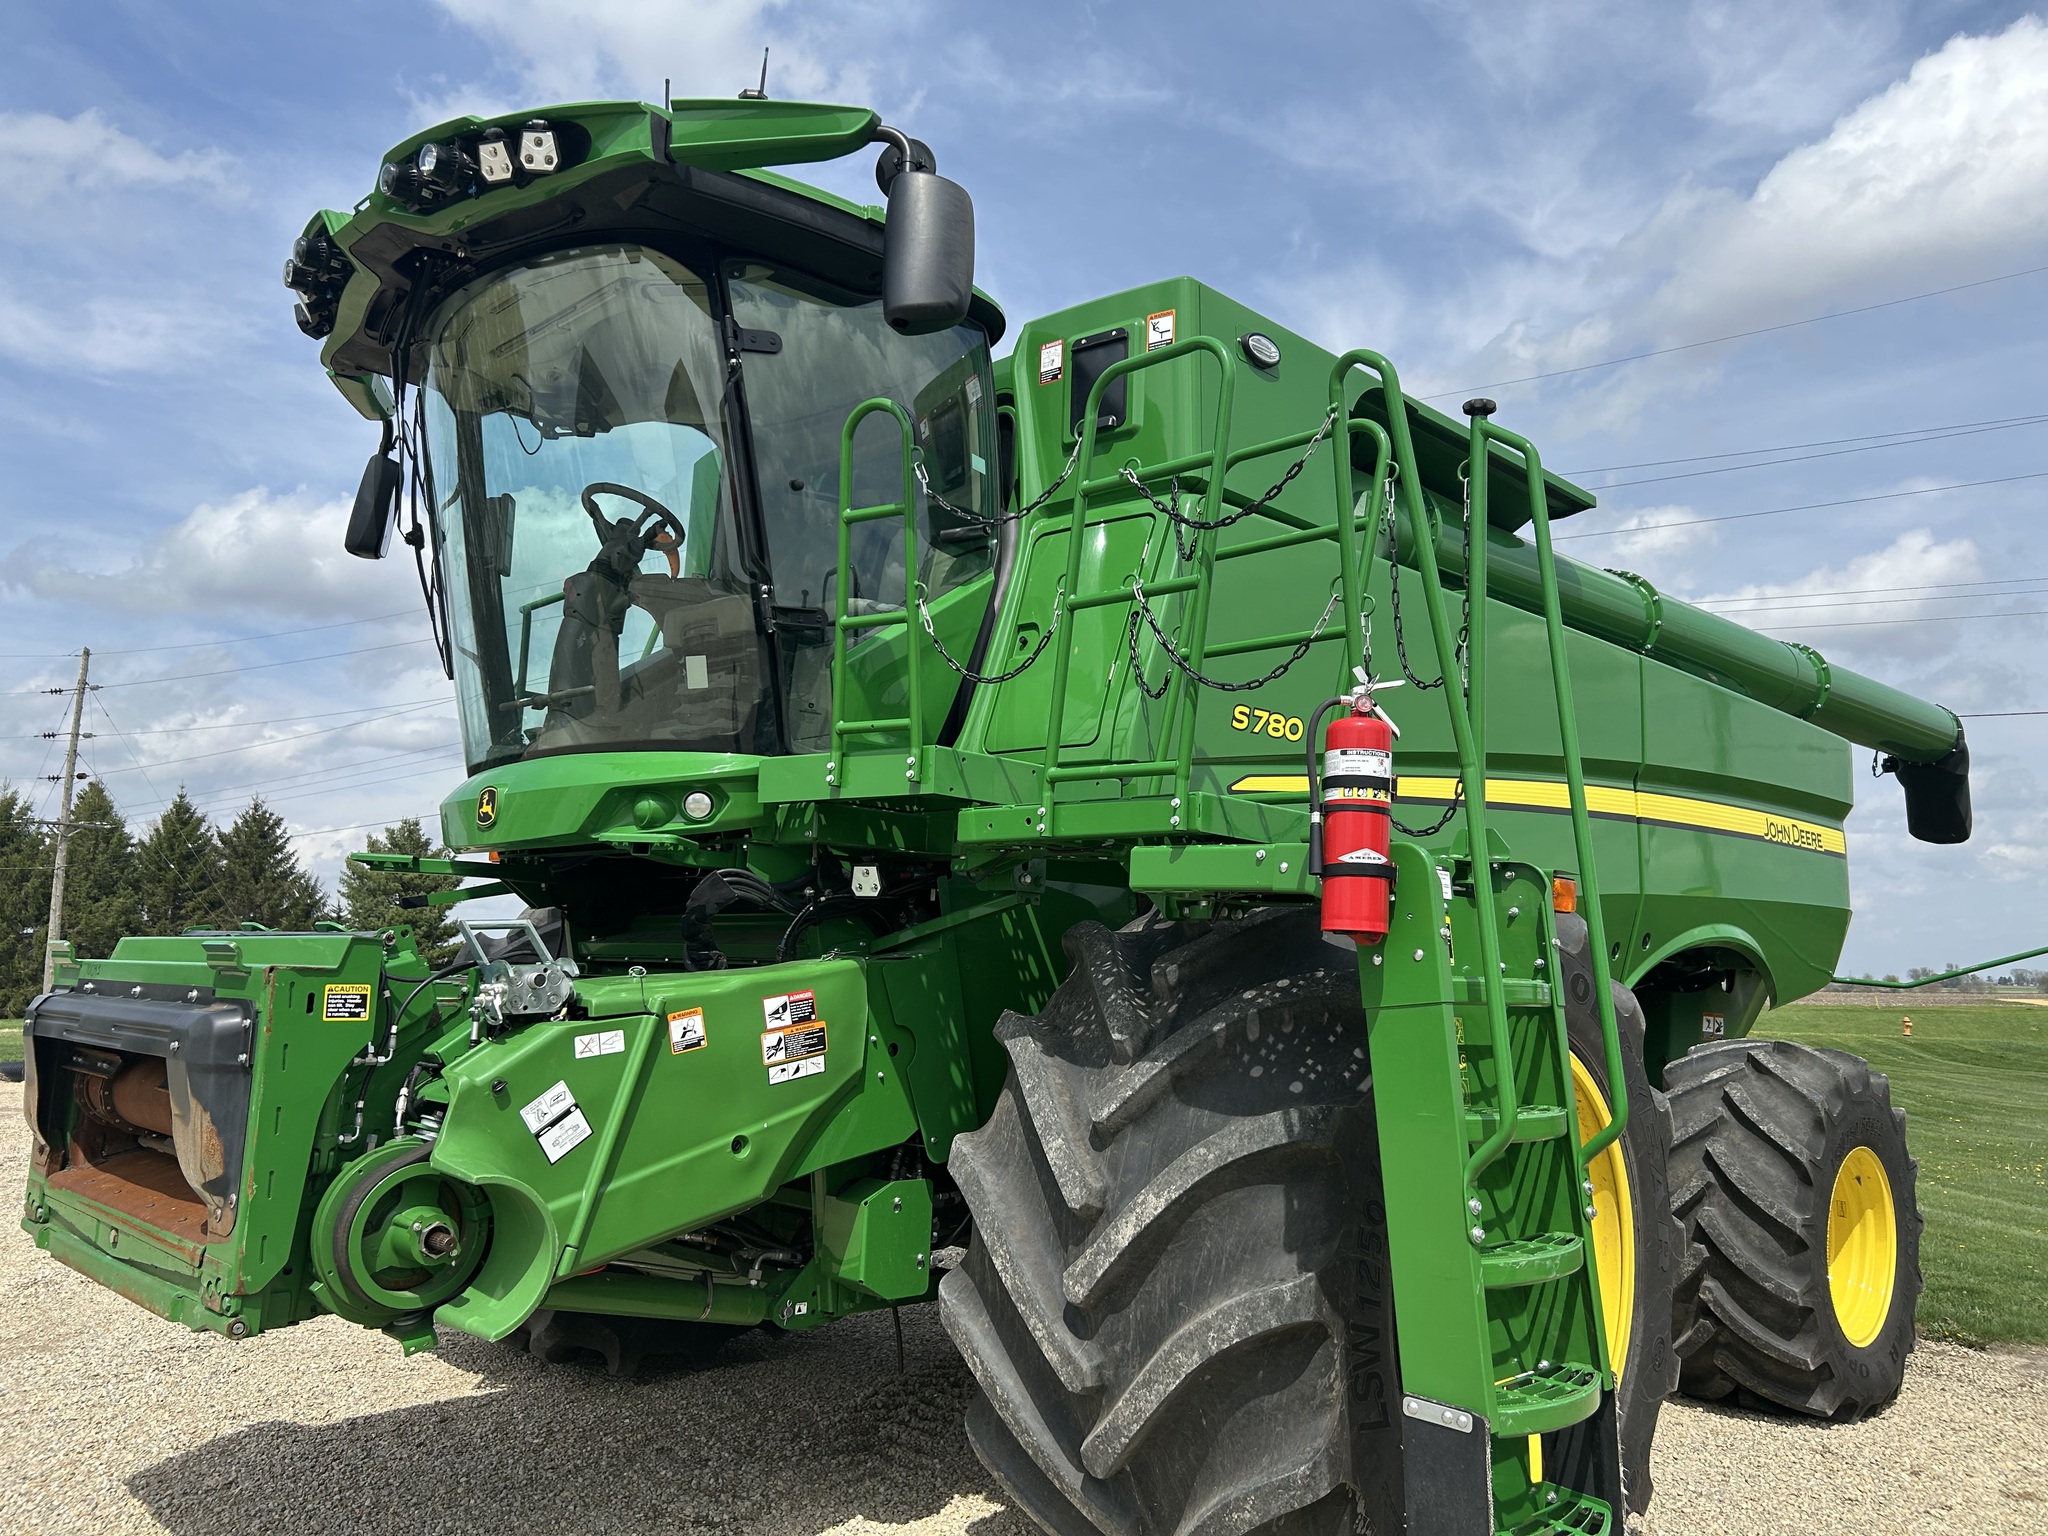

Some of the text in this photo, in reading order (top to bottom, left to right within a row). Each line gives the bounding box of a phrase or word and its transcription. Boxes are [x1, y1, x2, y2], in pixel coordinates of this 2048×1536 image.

[1231, 704, 1304, 742] S780
[1764, 817, 1824, 849] JOHN DEERE
[677, 1010, 698, 1018] WARNING
[1350, 1200, 1391, 1433] LSW 1250
